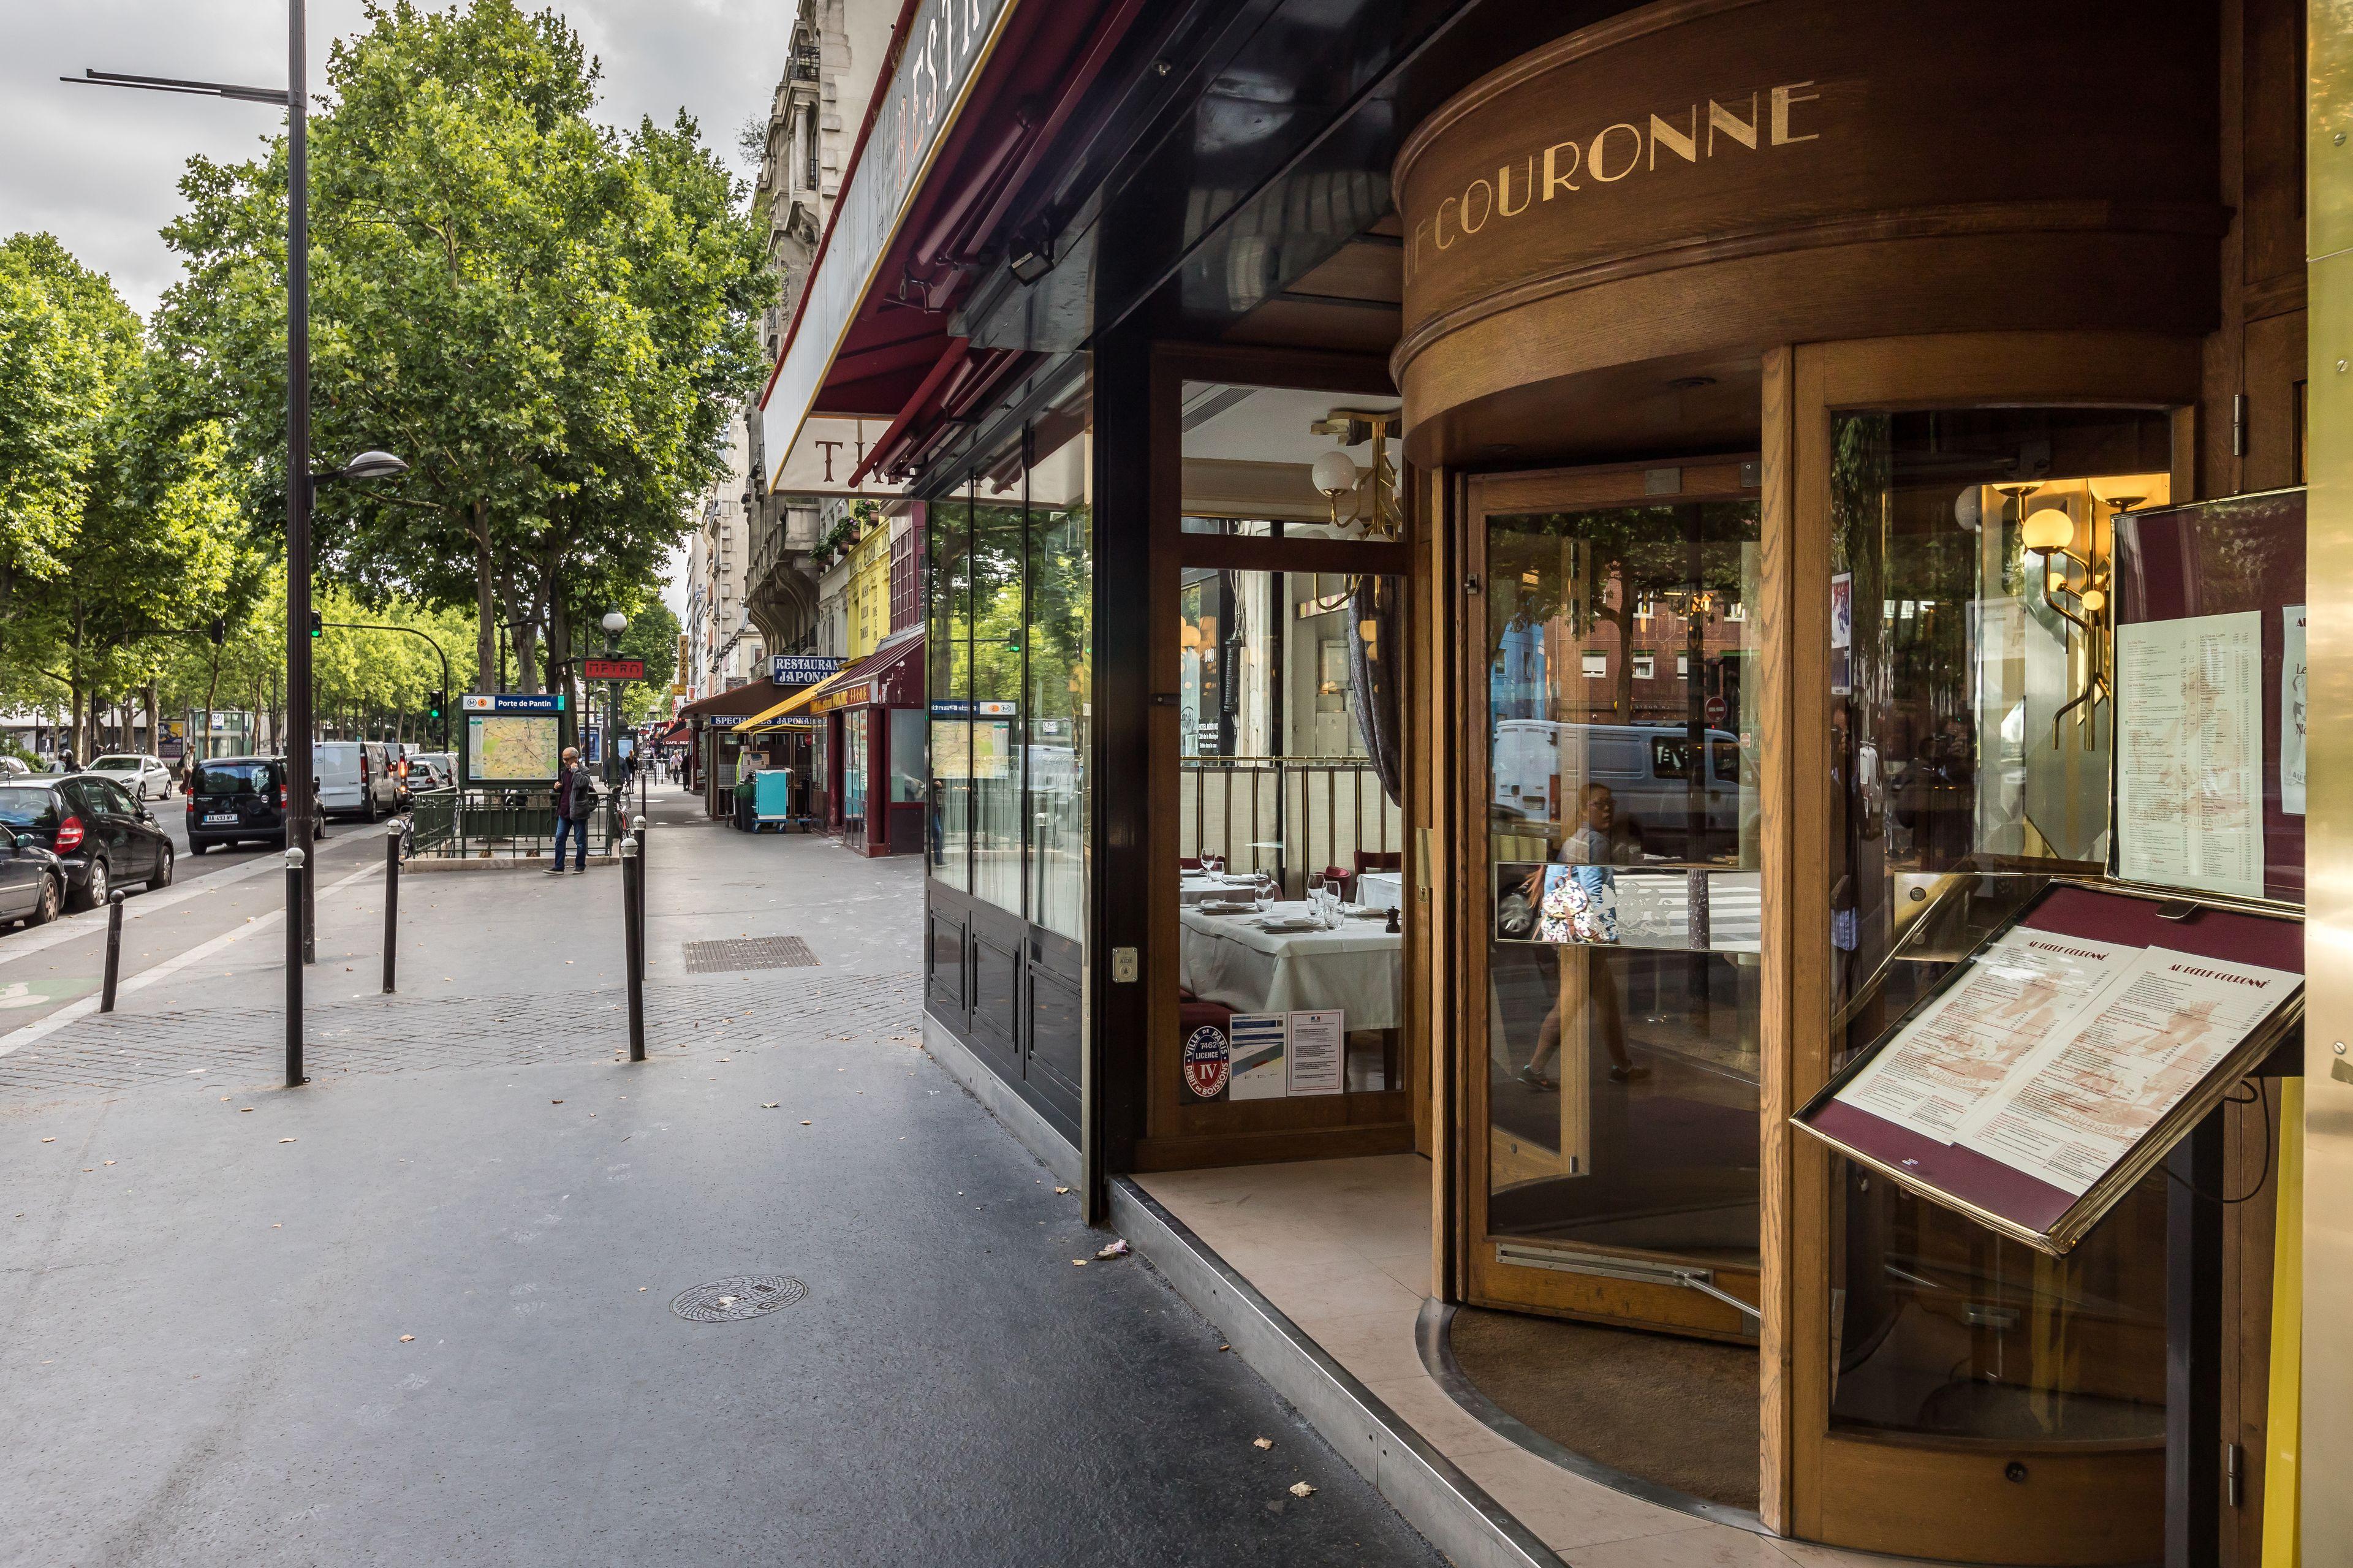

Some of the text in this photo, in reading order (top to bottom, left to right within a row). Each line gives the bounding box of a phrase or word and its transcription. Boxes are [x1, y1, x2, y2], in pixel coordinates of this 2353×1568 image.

[1205, 649, 1214, 662] 190
[589, 663, 640, 675] METRO
[779, 672, 835, 682] JAPONA
[1186, 1034, 1200, 1056] VILLE
[1211, 1031, 1228, 1055] PARIS
[1186, 1065, 1198, 1088] DEBIT
[1202, 1062, 1228, 1095] BOISSONS
[1200, 1064, 1218, 1079] IV
